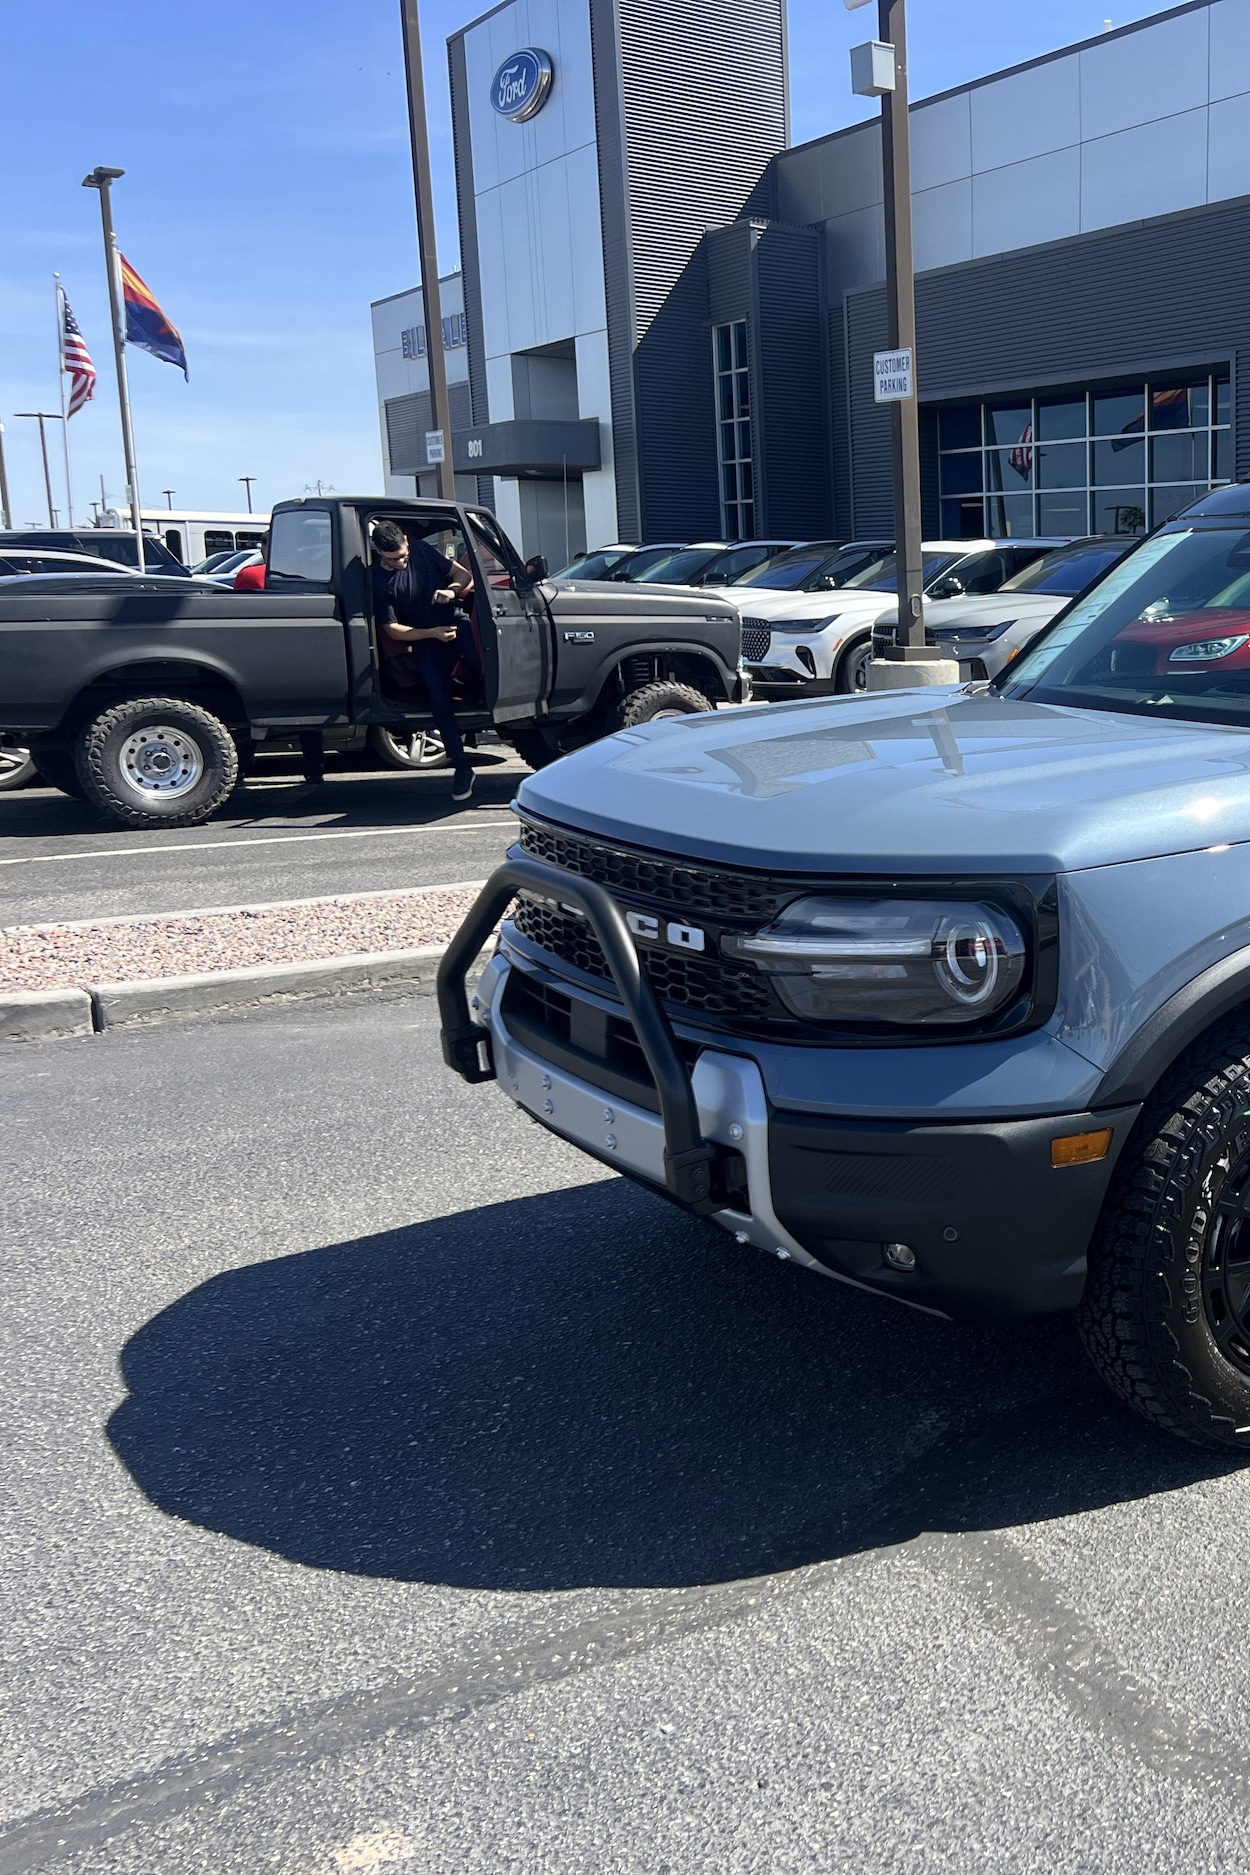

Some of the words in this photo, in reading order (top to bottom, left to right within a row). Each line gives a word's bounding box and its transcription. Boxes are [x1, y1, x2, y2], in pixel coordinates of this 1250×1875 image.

[498, 64, 527, 108] Ford
[401, 326, 424, 361] BIL
[875, 356, 910, 375] CUSTOMER
[879, 377, 908, 395] PARKING
[467, 438, 483, 459] 801
